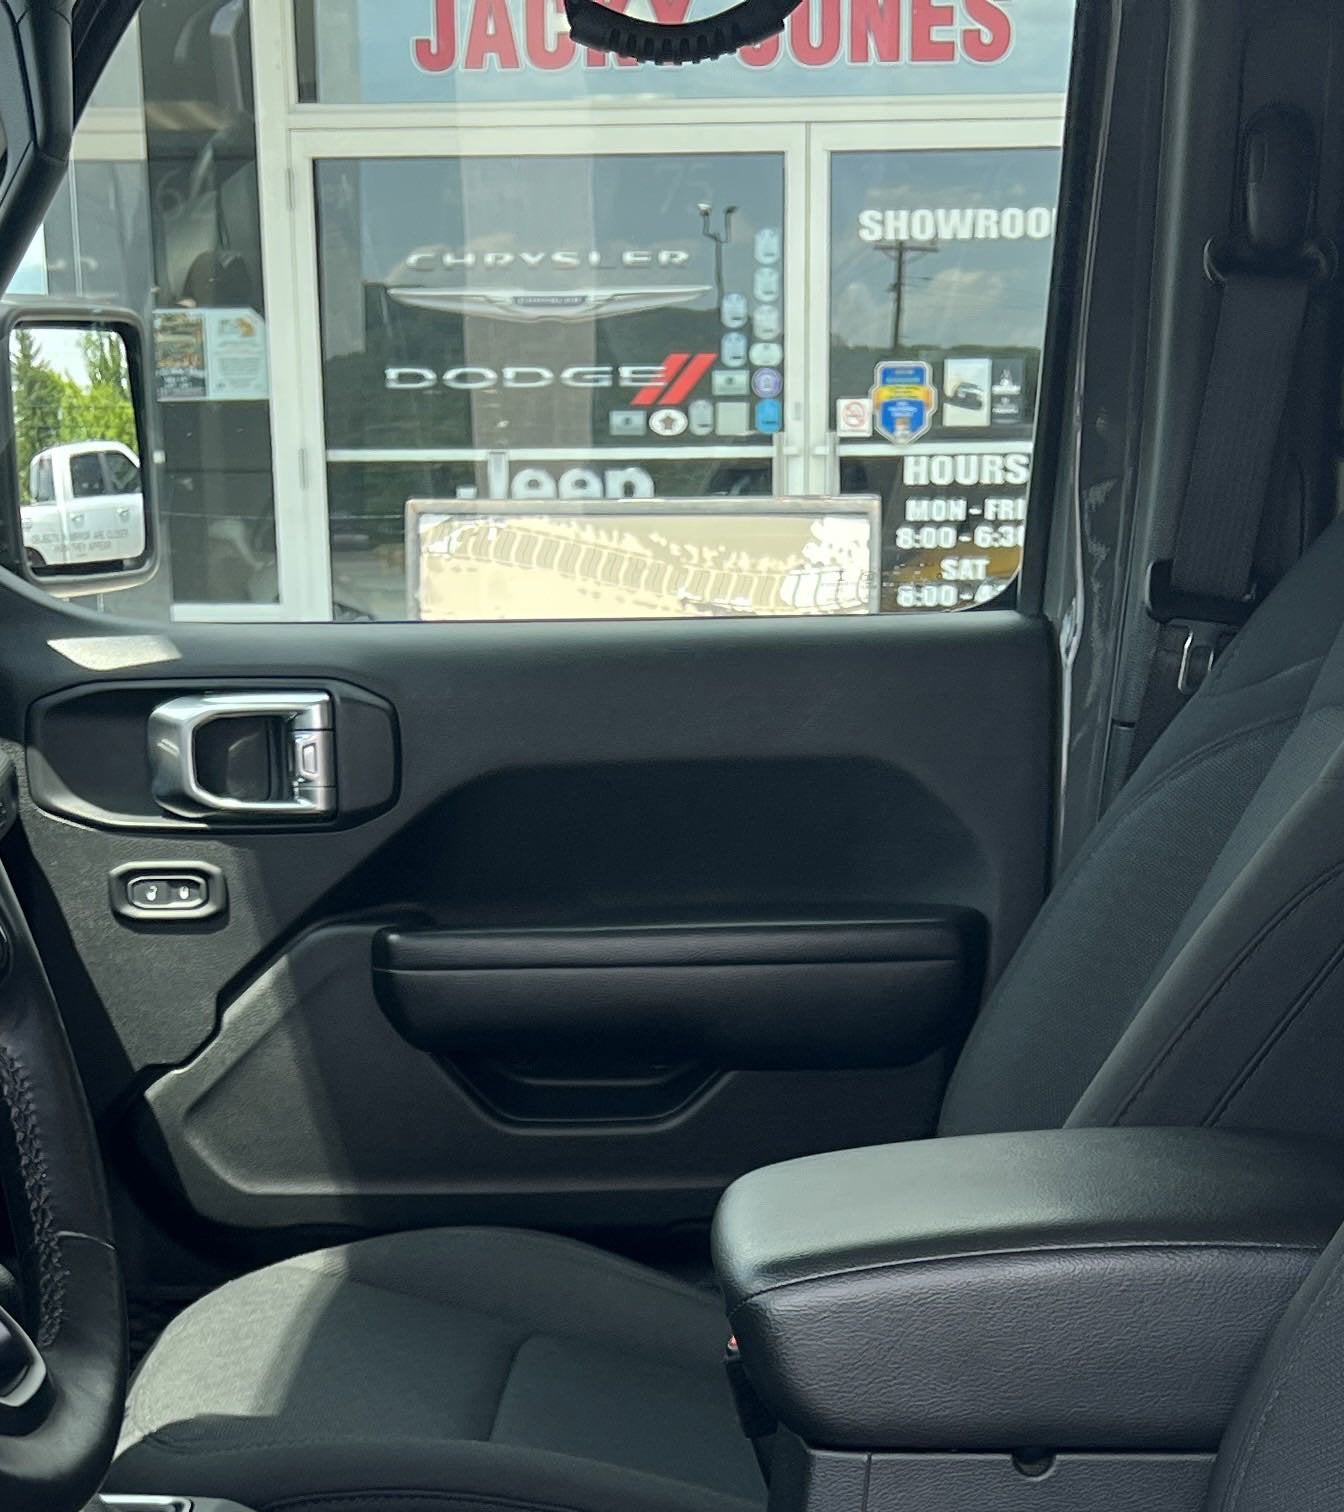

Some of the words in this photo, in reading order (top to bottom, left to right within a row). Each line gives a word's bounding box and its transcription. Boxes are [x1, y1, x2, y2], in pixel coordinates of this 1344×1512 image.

[858, 206, 1056, 242] SHOWROO
[384, 366, 668, 390] DODGE
[902, 454, 1031, 486] HOURS
[939, 557, 991, 581] SAT
